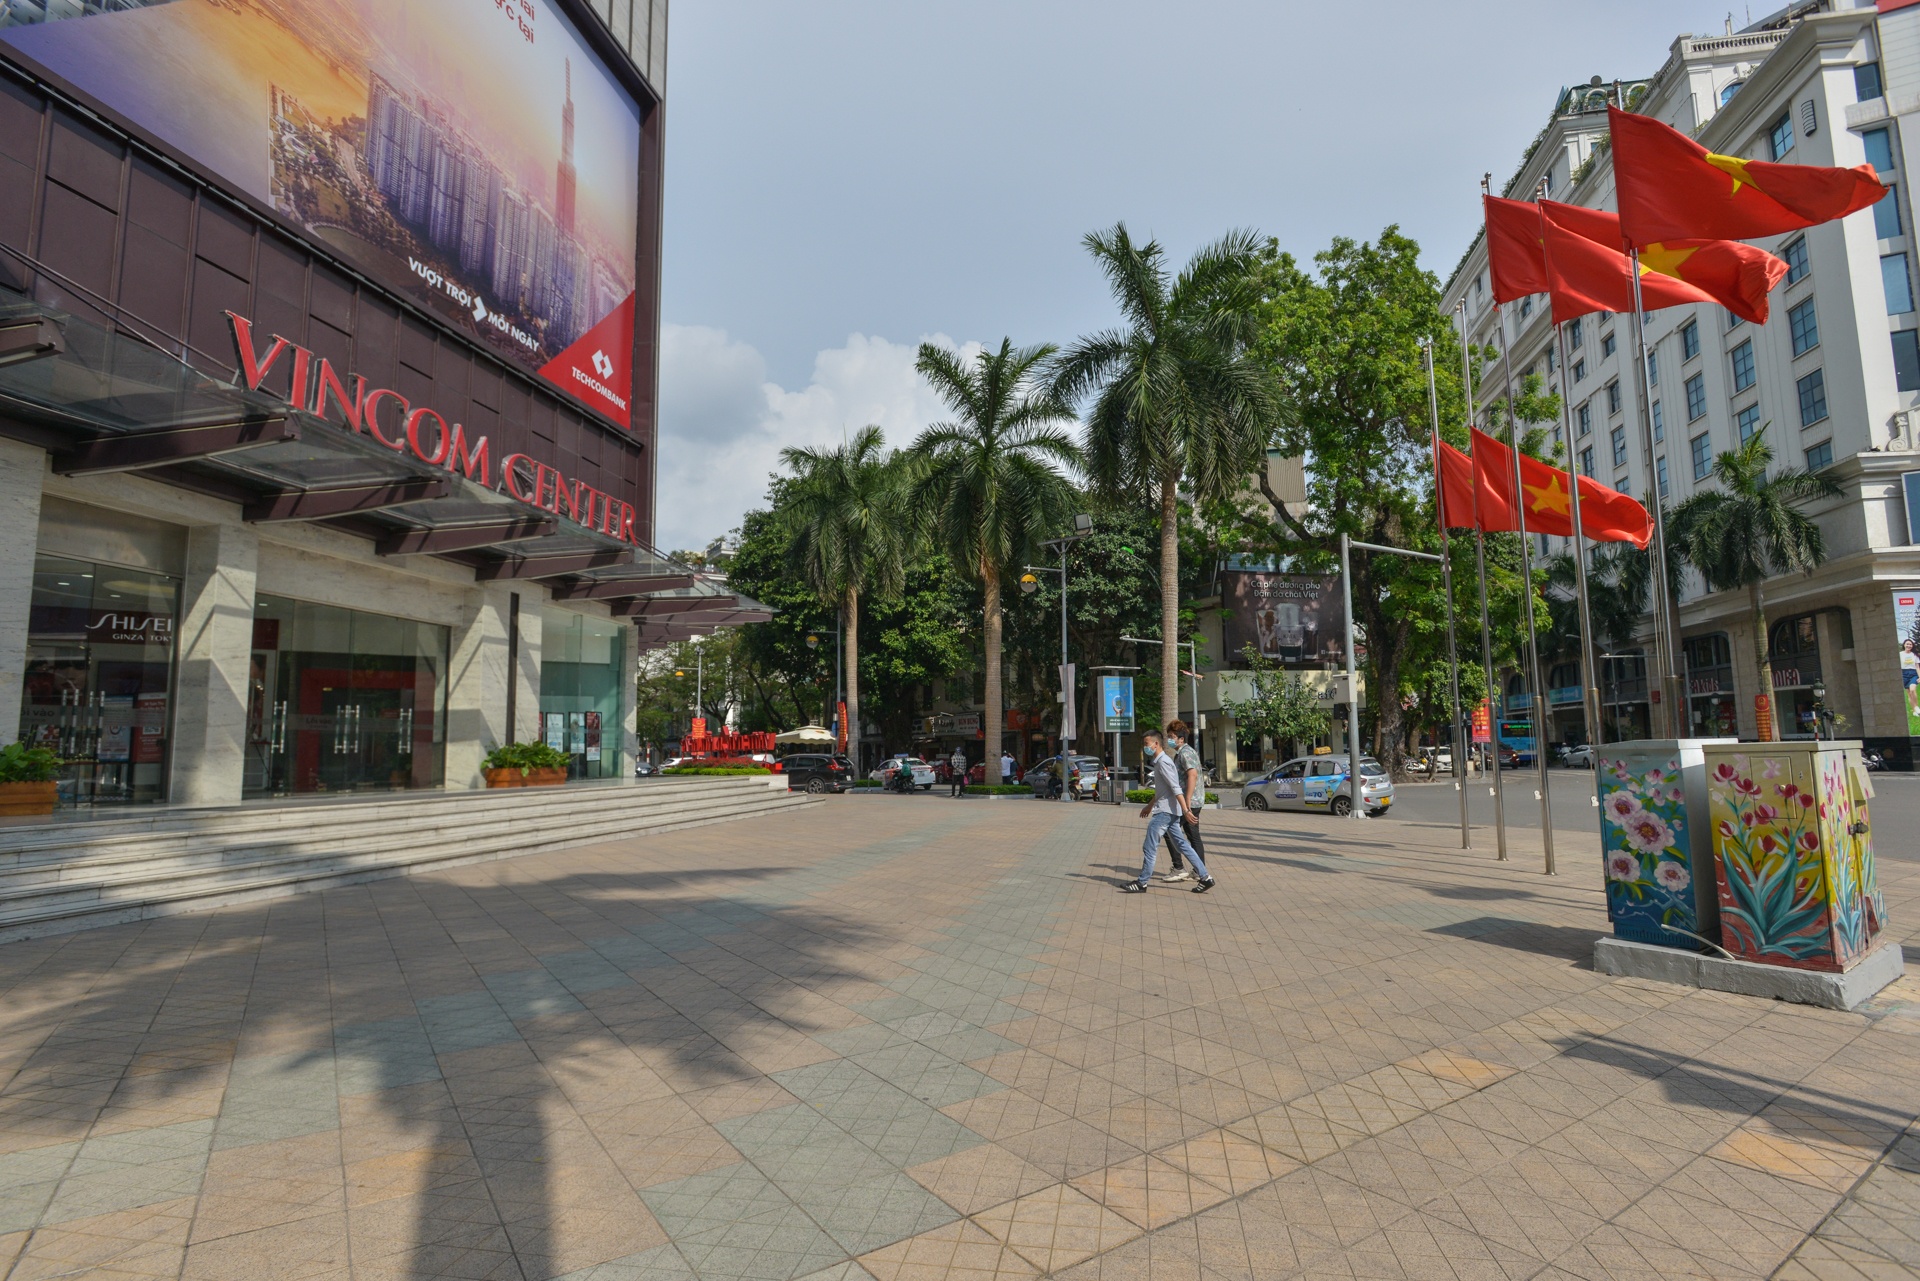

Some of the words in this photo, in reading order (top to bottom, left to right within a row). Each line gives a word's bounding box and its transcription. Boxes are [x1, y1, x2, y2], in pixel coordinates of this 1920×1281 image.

[518, 15, 533, 43] tại
[408, 256, 443, 288] VƯỢT
[445, 281, 471, 307] TRỘI
[510, 325, 540, 352] NGÀY
[572, 366, 626, 411] TECHCOMBANK
[224, 309, 494, 489] VINCOM
[502, 452, 638, 547] CENTER
[112, 633, 144, 641] GINZA
